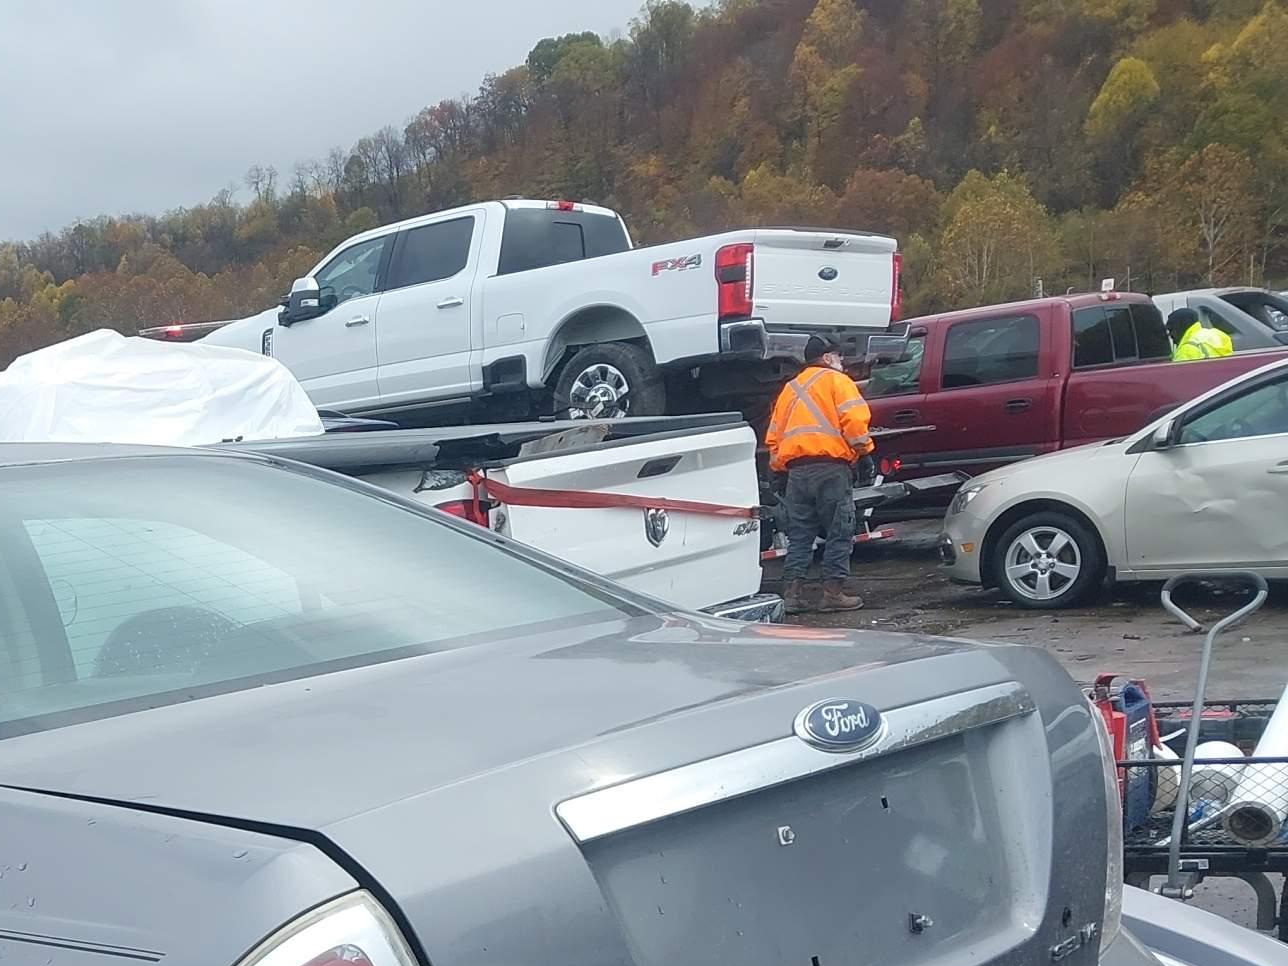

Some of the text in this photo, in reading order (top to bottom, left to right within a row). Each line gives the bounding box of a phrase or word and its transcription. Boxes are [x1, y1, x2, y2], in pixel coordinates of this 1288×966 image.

[651, 254, 702, 276] FX4
[821, 702, 870, 737] Ford
[1048, 935, 1081, 961] SEL
